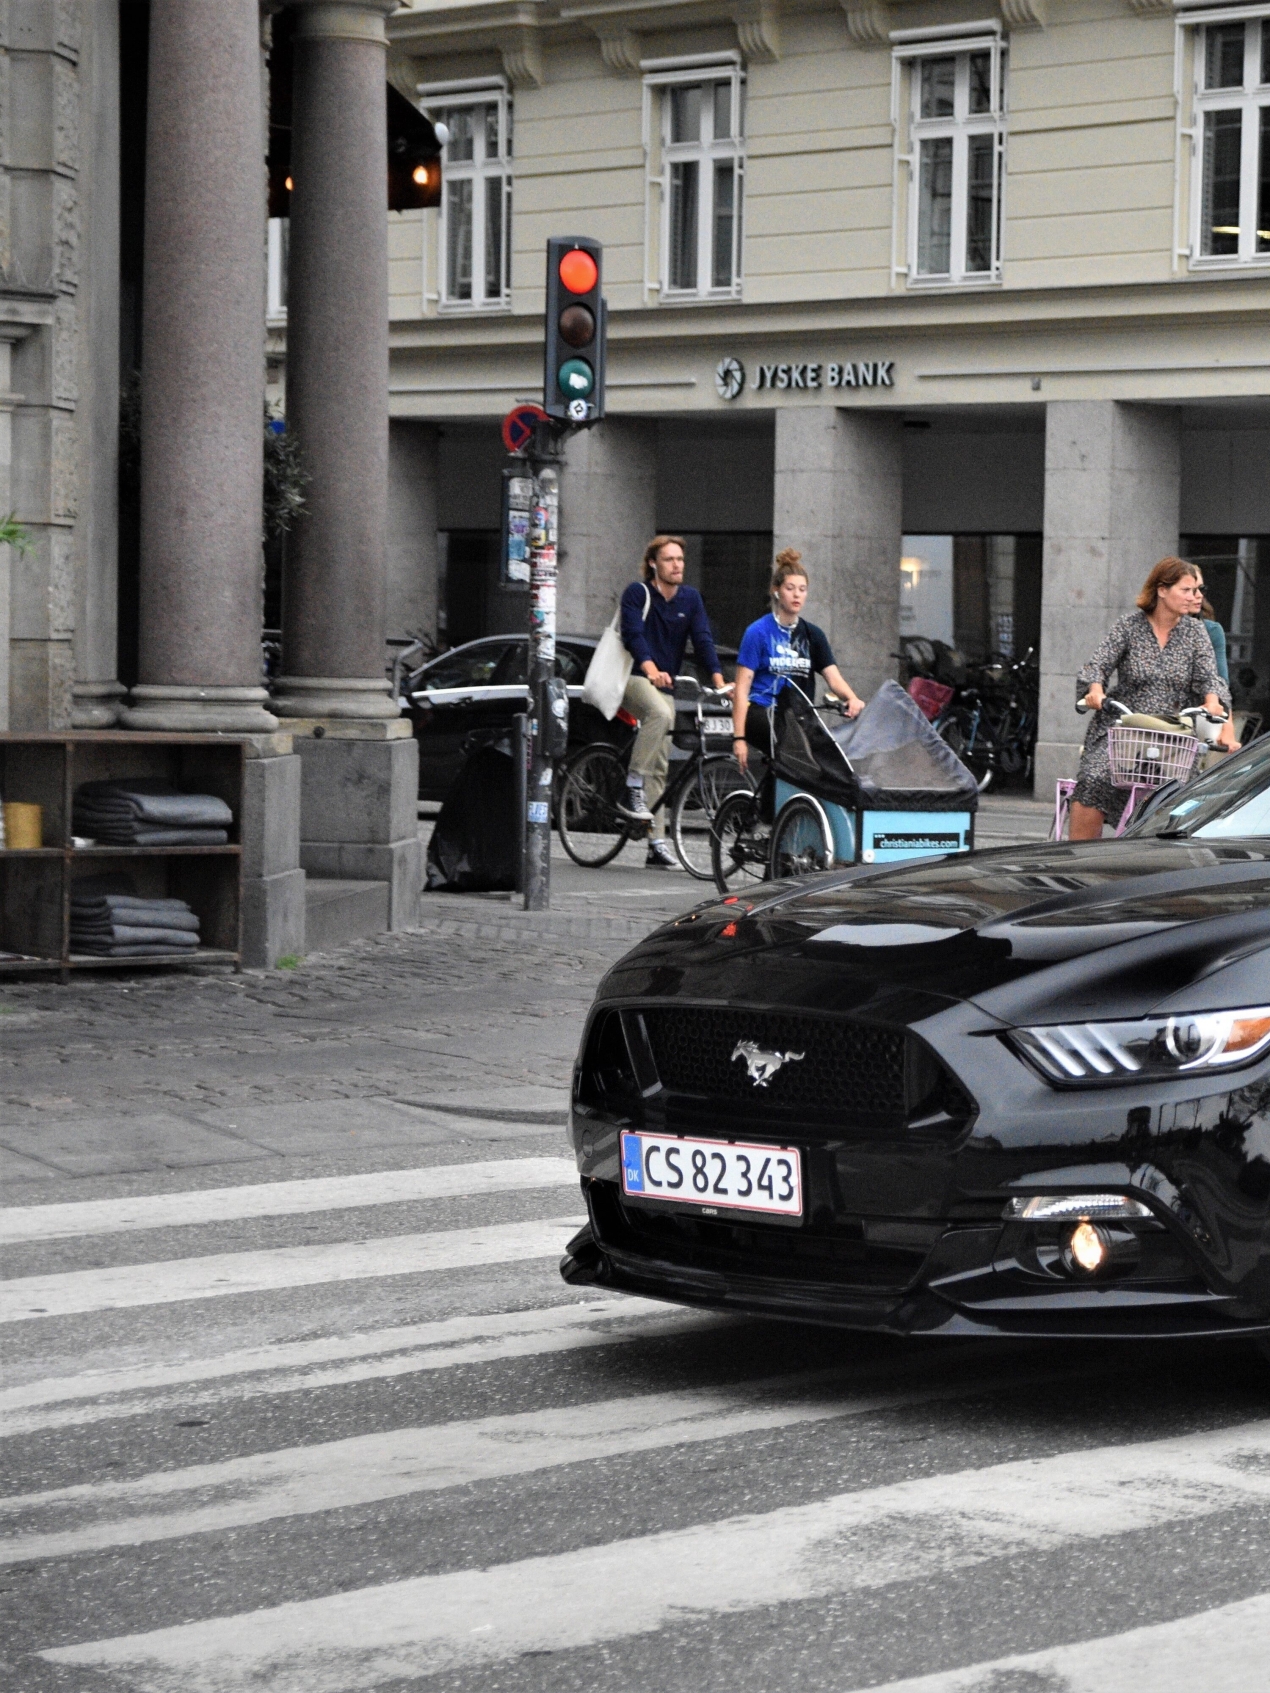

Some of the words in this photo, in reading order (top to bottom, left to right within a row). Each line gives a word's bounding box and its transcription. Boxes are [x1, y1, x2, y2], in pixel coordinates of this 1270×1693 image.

[751, 363, 822, 391] JYSKE
[826, 360, 894, 387] BANK
[880, 838, 958, 849] christianiabikes.com
[627, 1168, 640, 1182] DK
[644, 1145, 684, 1189] CS
